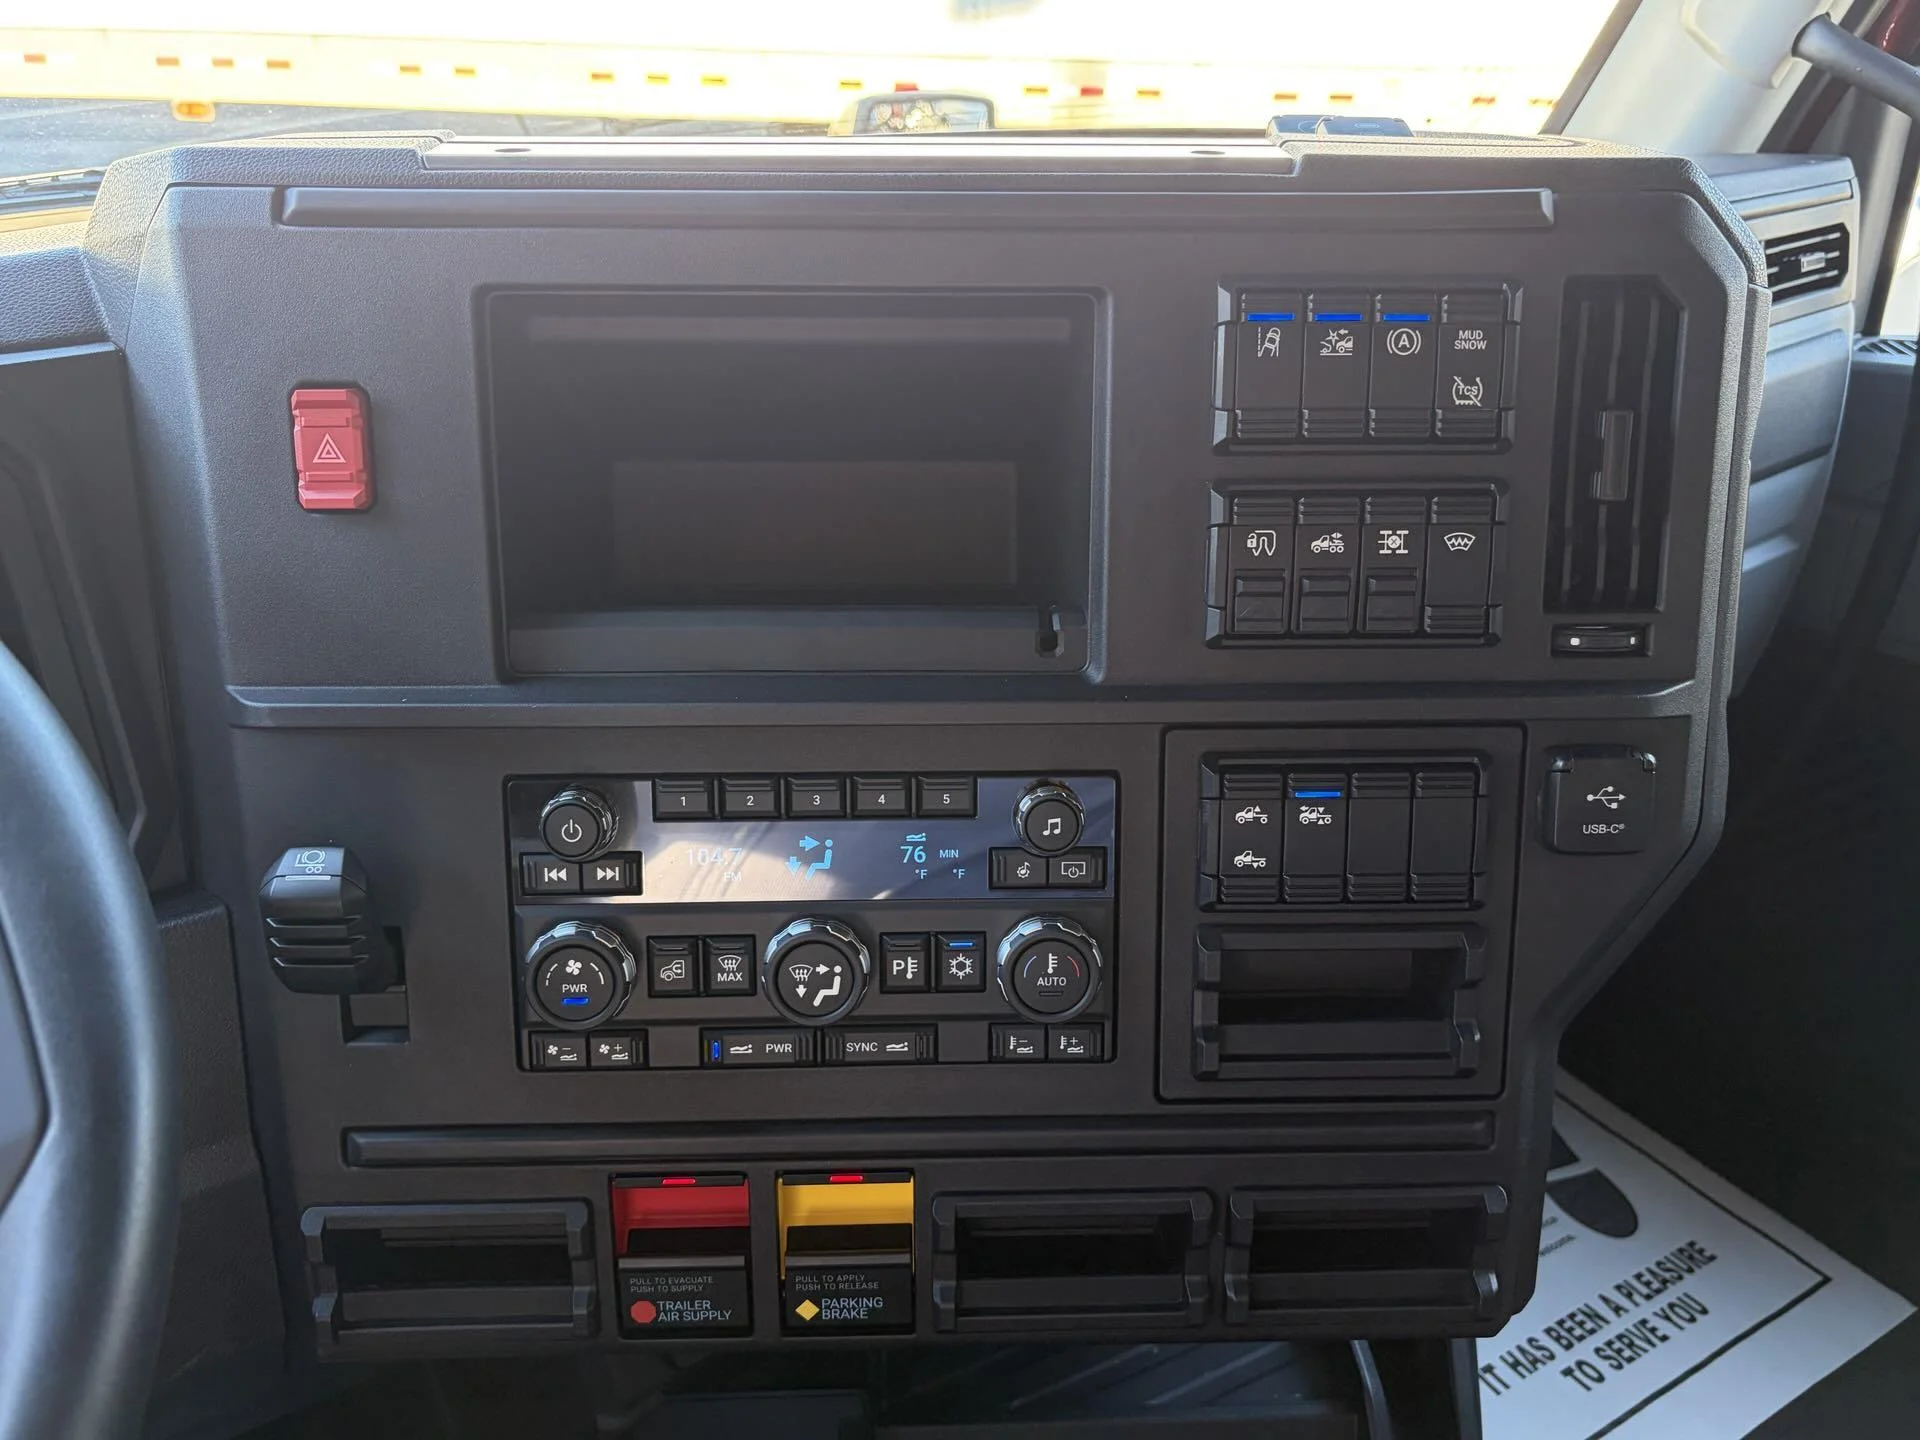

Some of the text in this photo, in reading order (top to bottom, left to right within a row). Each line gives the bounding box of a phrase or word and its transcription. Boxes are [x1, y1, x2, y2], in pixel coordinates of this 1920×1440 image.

[1458, 330, 1483, 341] MUD
[1454, 339, 1487, 350] SNOW
[1458, 385, 1478, 396] TCS
[680, 796, 687, 806] 1
[746, 795, 754, 806] 2
[812, 795, 821, 806] 3
[877, 794, 886, 805] 4
[943, 794, 950, 804] 5
[900, 845, 926, 863] 76
[939, 849, 959, 858] MIN
[717, 972, 743, 982] MAX
[1036, 976, 1067, 987] AUTO
[562, 983, 588, 993] PWR
[765, 1043, 793, 1053] PWR
[846, 1041, 878, 1052] SYNC
[630, 1277, 652, 1285] PULL
[668, 1276, 713, 1284] EVACUATE
[795, 1274, 865, 1283] PULL TO APPLY
[630, 1285, 655, 1293] PUSH
[671, 1284, 704, 1292] SUPPLY
[795, 1283, 821, 1291] PUSH
[838, 1282, 880, 1290] RELEASE
[656, 1300, 711, 1311] TRAILER
[821, 1297, 884, 1309] PARKING
[657, 1309, 732, 1322] AIR SUPPLY
[821, 1308, 869, 1320] BRAKE
[1478, 1363, 1511, 1396] IT
[1499, 1337, 1557, 1379] HAS
[1542, 1303, 1611, 1352] BEEN
[1597, 1293, 1629, 1319] A
[1613, 1240, 1718, 1308] PLEASURE
[1560, 1292, 1710, 1392] TO SERVE YOU
